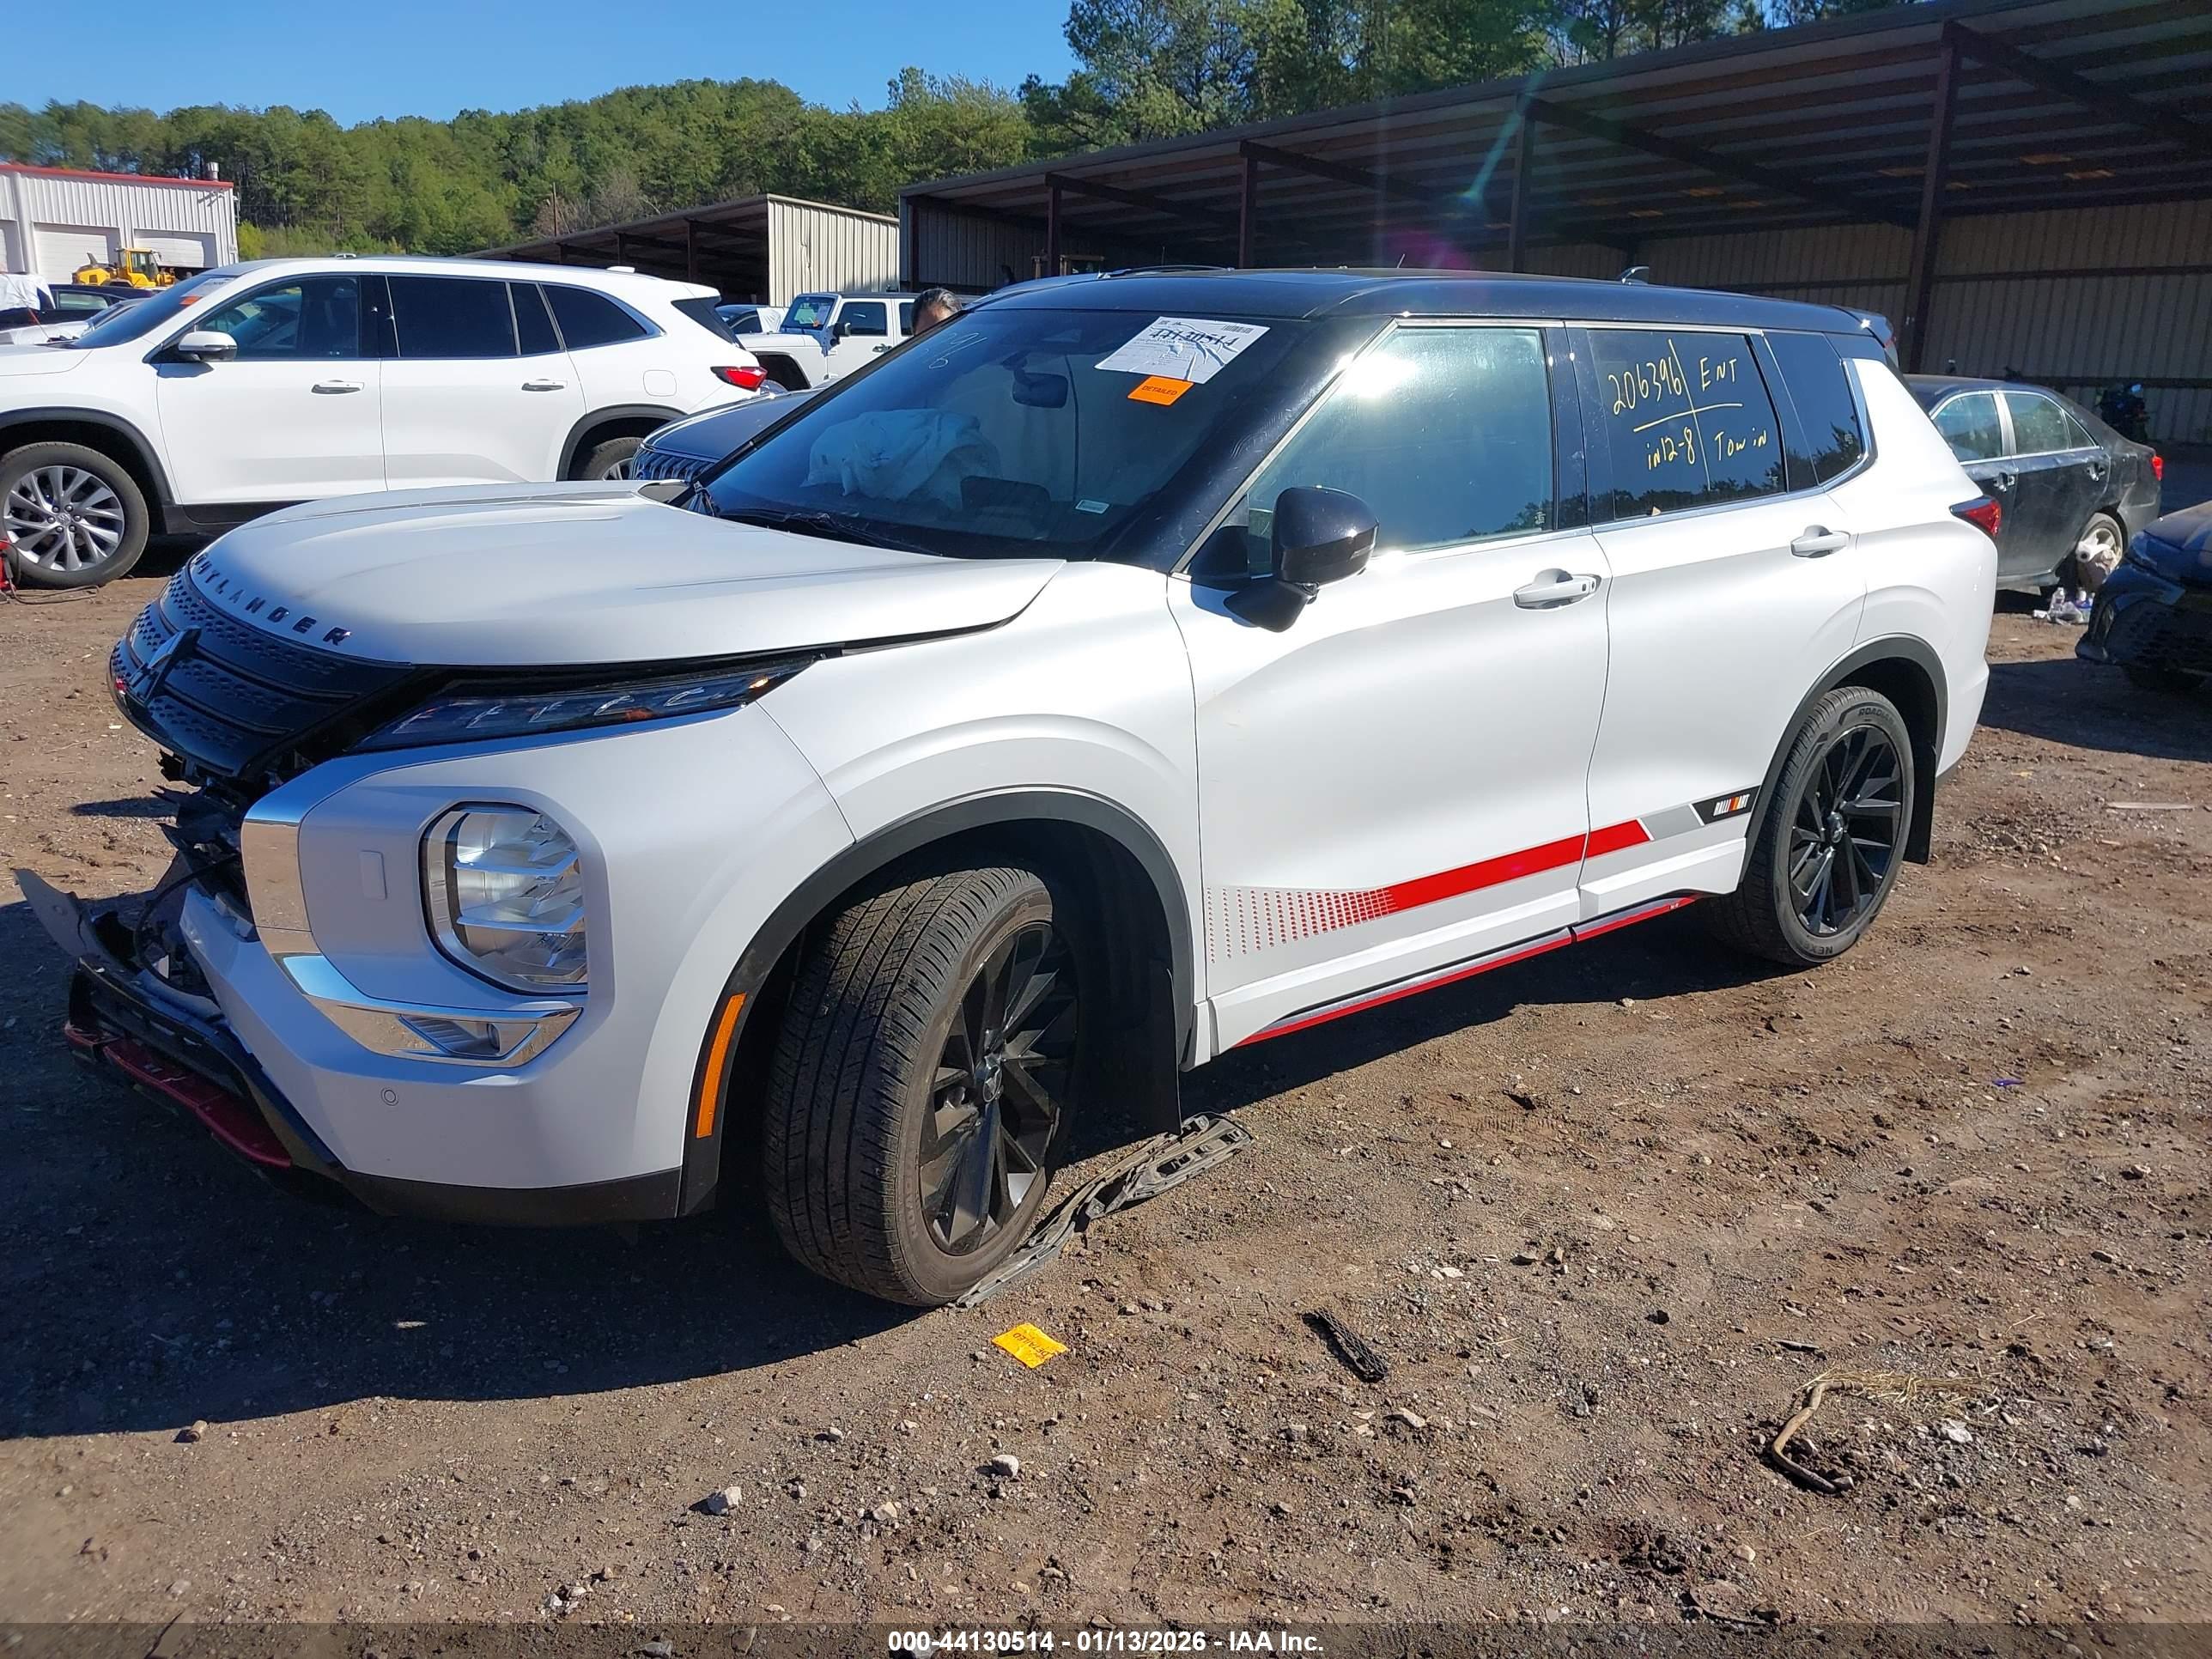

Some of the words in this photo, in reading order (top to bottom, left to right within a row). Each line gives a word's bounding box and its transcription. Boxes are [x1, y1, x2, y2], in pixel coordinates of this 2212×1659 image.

[1141, 384, 1178, 396] DETAILED
[1607, 356, 1682, 415] 206396
[1699, 356, 1737, 392] ENT
[1012, 1332, 1049, 1358] DETAILED
